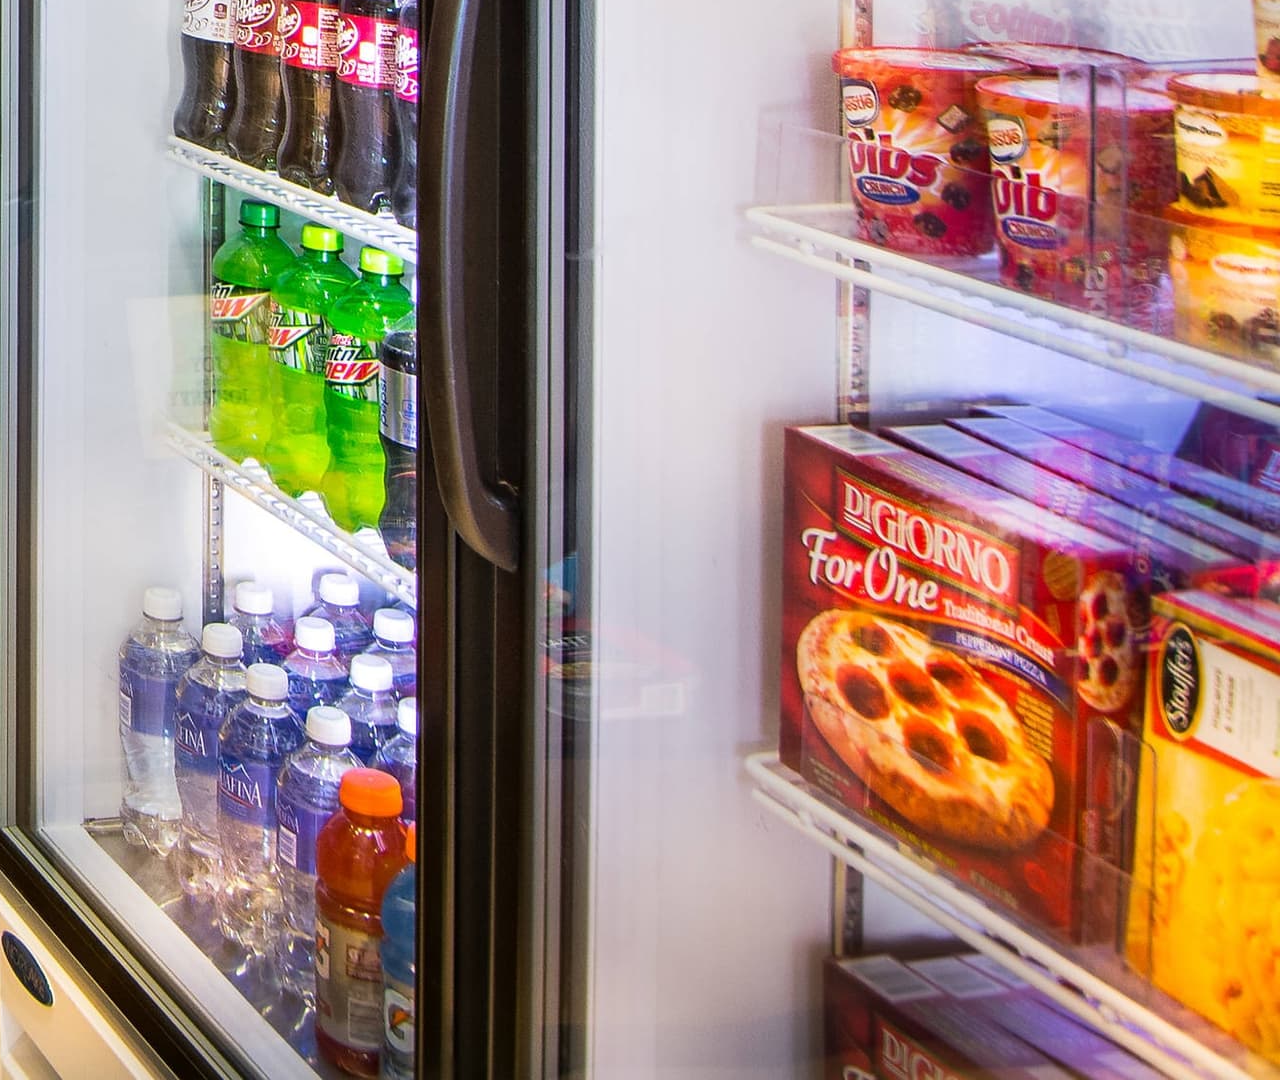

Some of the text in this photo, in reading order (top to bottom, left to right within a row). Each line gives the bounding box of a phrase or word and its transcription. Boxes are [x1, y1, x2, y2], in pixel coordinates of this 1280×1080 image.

[862, 180, 906, 197] CRUNCH
[800, 526, 941, 613] For One
[942, 598, 1055, 667] Traditional Crust
[956, 632, 1048, 686] PEPPERONI PIZZA
[1167, 637, 1196, 729] Stouffer's
